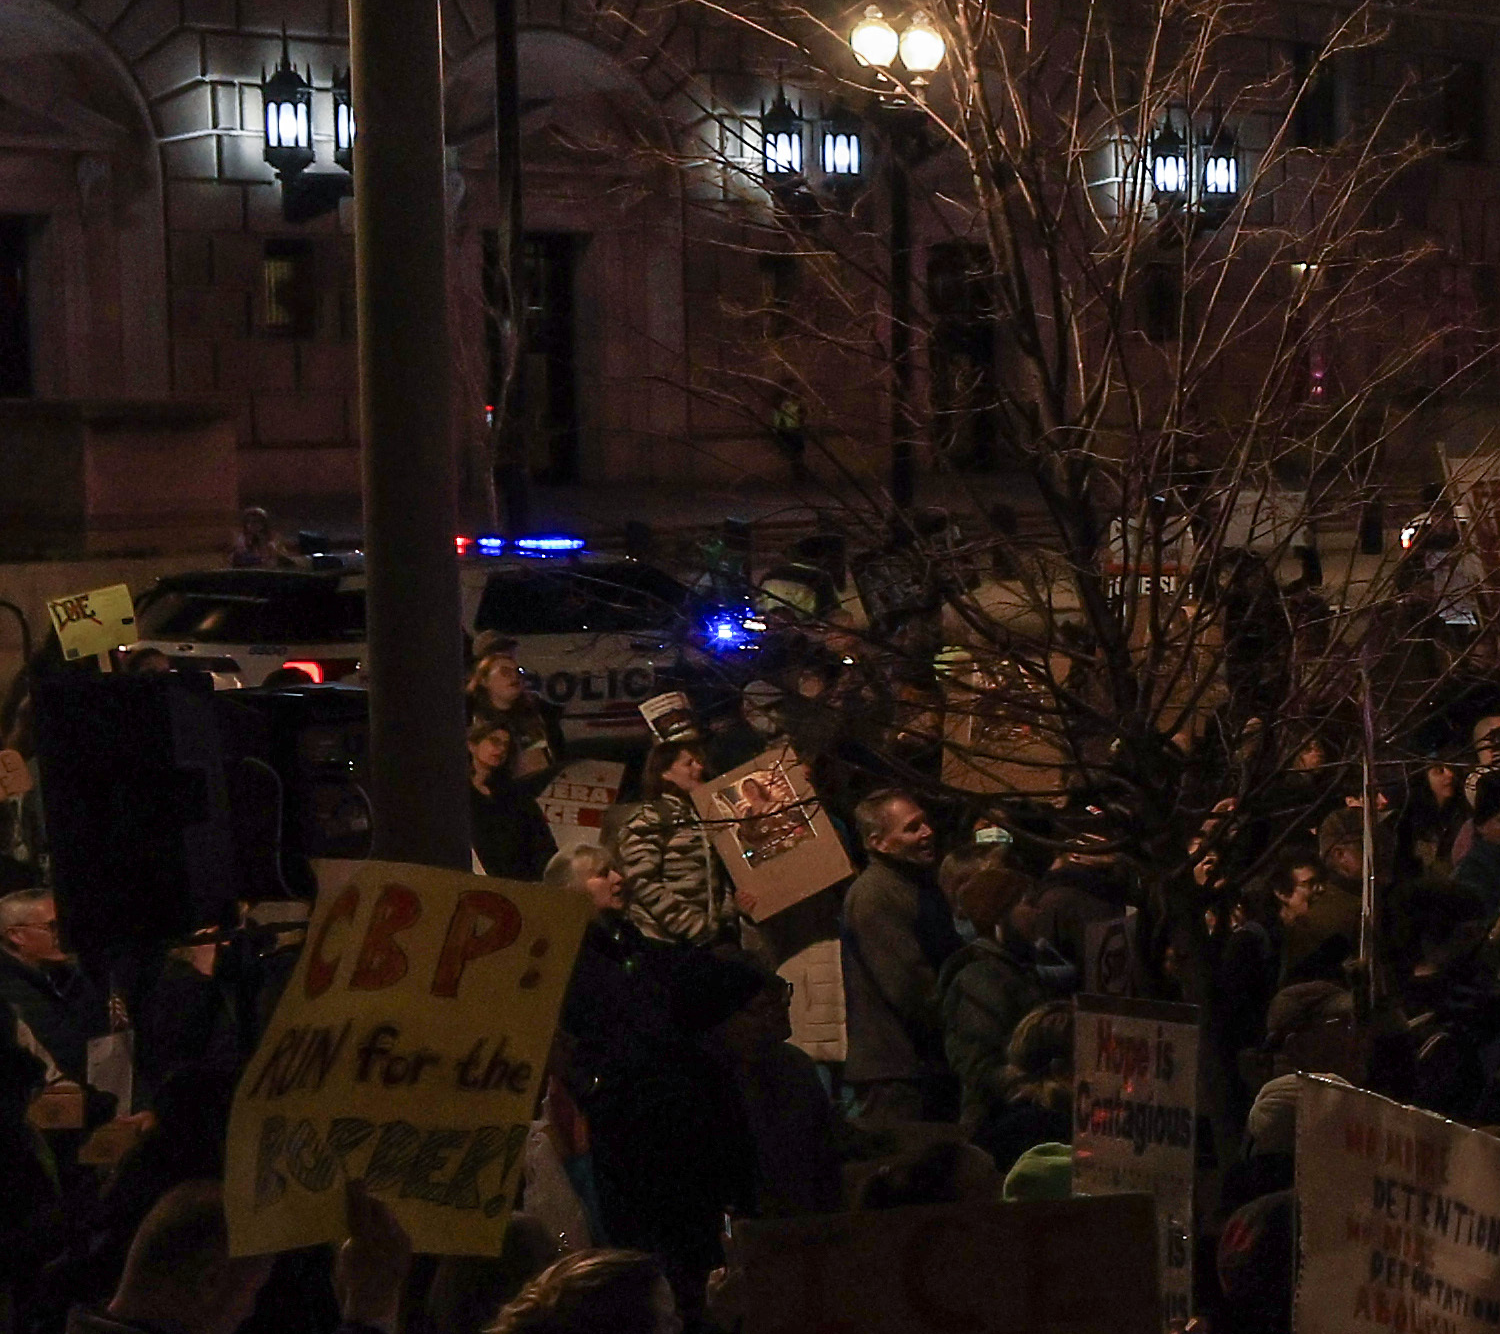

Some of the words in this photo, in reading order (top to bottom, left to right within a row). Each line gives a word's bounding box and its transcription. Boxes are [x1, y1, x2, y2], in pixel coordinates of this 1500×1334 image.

[304, 882, 550, 1000] CBP:
[248, 1017, 355, 1101] RUN
[356, 1020, 441, 1088] for
[455, 1031, 534, 1094] the
[1096, 1019, 1150, 1080] Hope
[1156, 1023, 1175, 1081] is
[1076, 1078, 1192, 1157] Contagious
[252, 1114, 531, 1219] BORDER!
